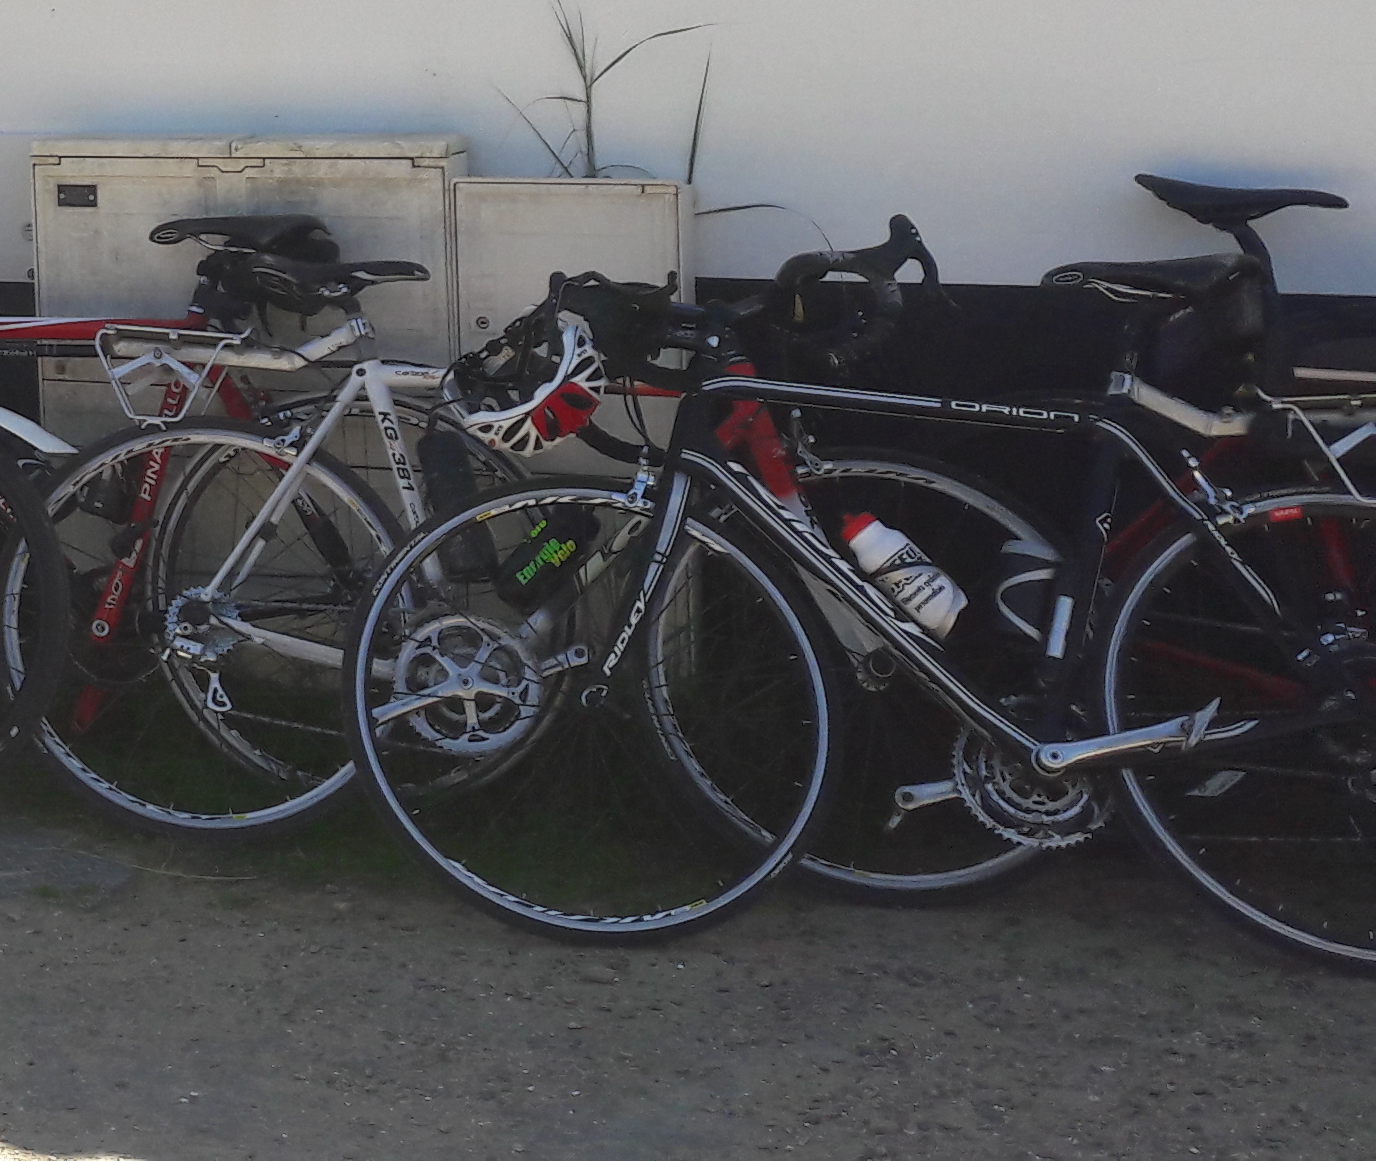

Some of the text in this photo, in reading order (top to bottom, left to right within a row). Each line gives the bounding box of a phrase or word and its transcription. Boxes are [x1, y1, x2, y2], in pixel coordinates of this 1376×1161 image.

[378, 411, 415, 492] KG 381
[950, 400, 1080, 423] ORION
[602, 589, 646, 678] RIDLEY
